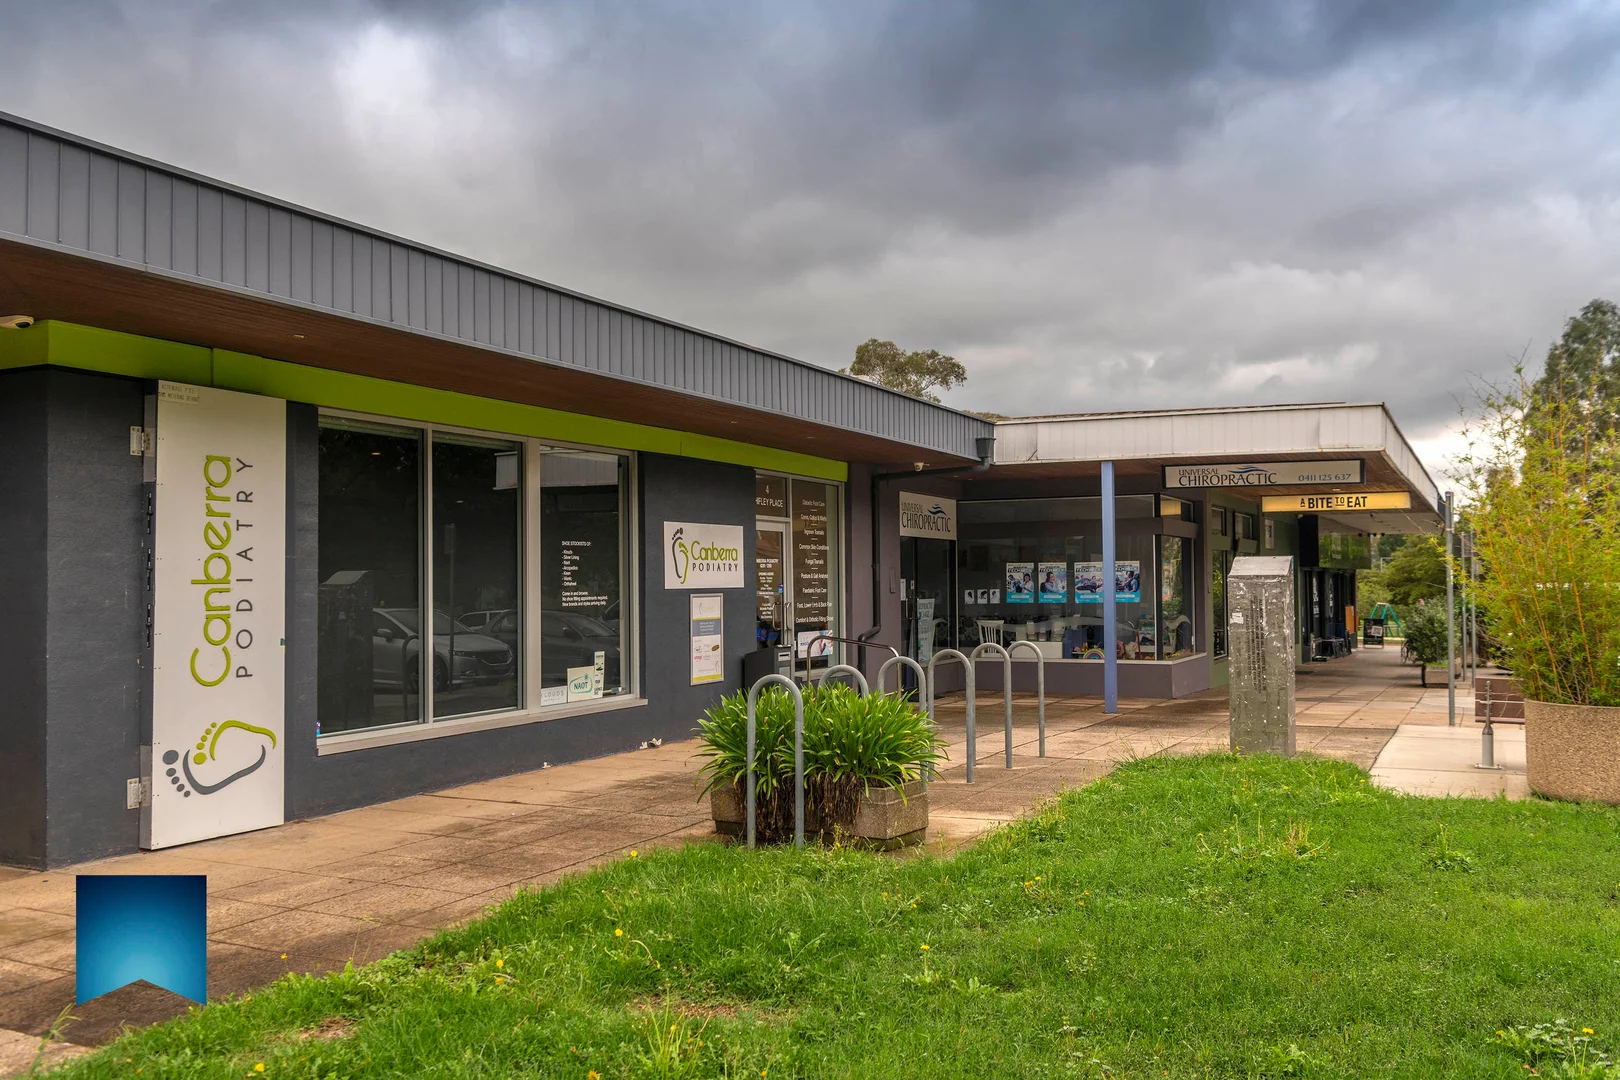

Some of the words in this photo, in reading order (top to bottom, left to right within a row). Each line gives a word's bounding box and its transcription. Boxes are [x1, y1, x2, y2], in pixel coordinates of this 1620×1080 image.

[1178, 468, 1220, 476] UNIVERSAL
[1178, 472, 1278, 486] CHIROPRACTIC
[765, 484, 770, 494] 4
[770, 498, 783, 508] PLACE
[1308, 497, 1332, 508] BITE
[1347, 496, 1368, 508] EAT
[901, 512, 952, 532] CHIROPRACTIC
[690, 540, 738, 561] Canberra
[190, 454, 232, 687] Canberra
[236, 458, 253, 678] PODIATRY
[692, 563, 738, 571] PODIATRY
[574, 682, 588, 690] NAOT
